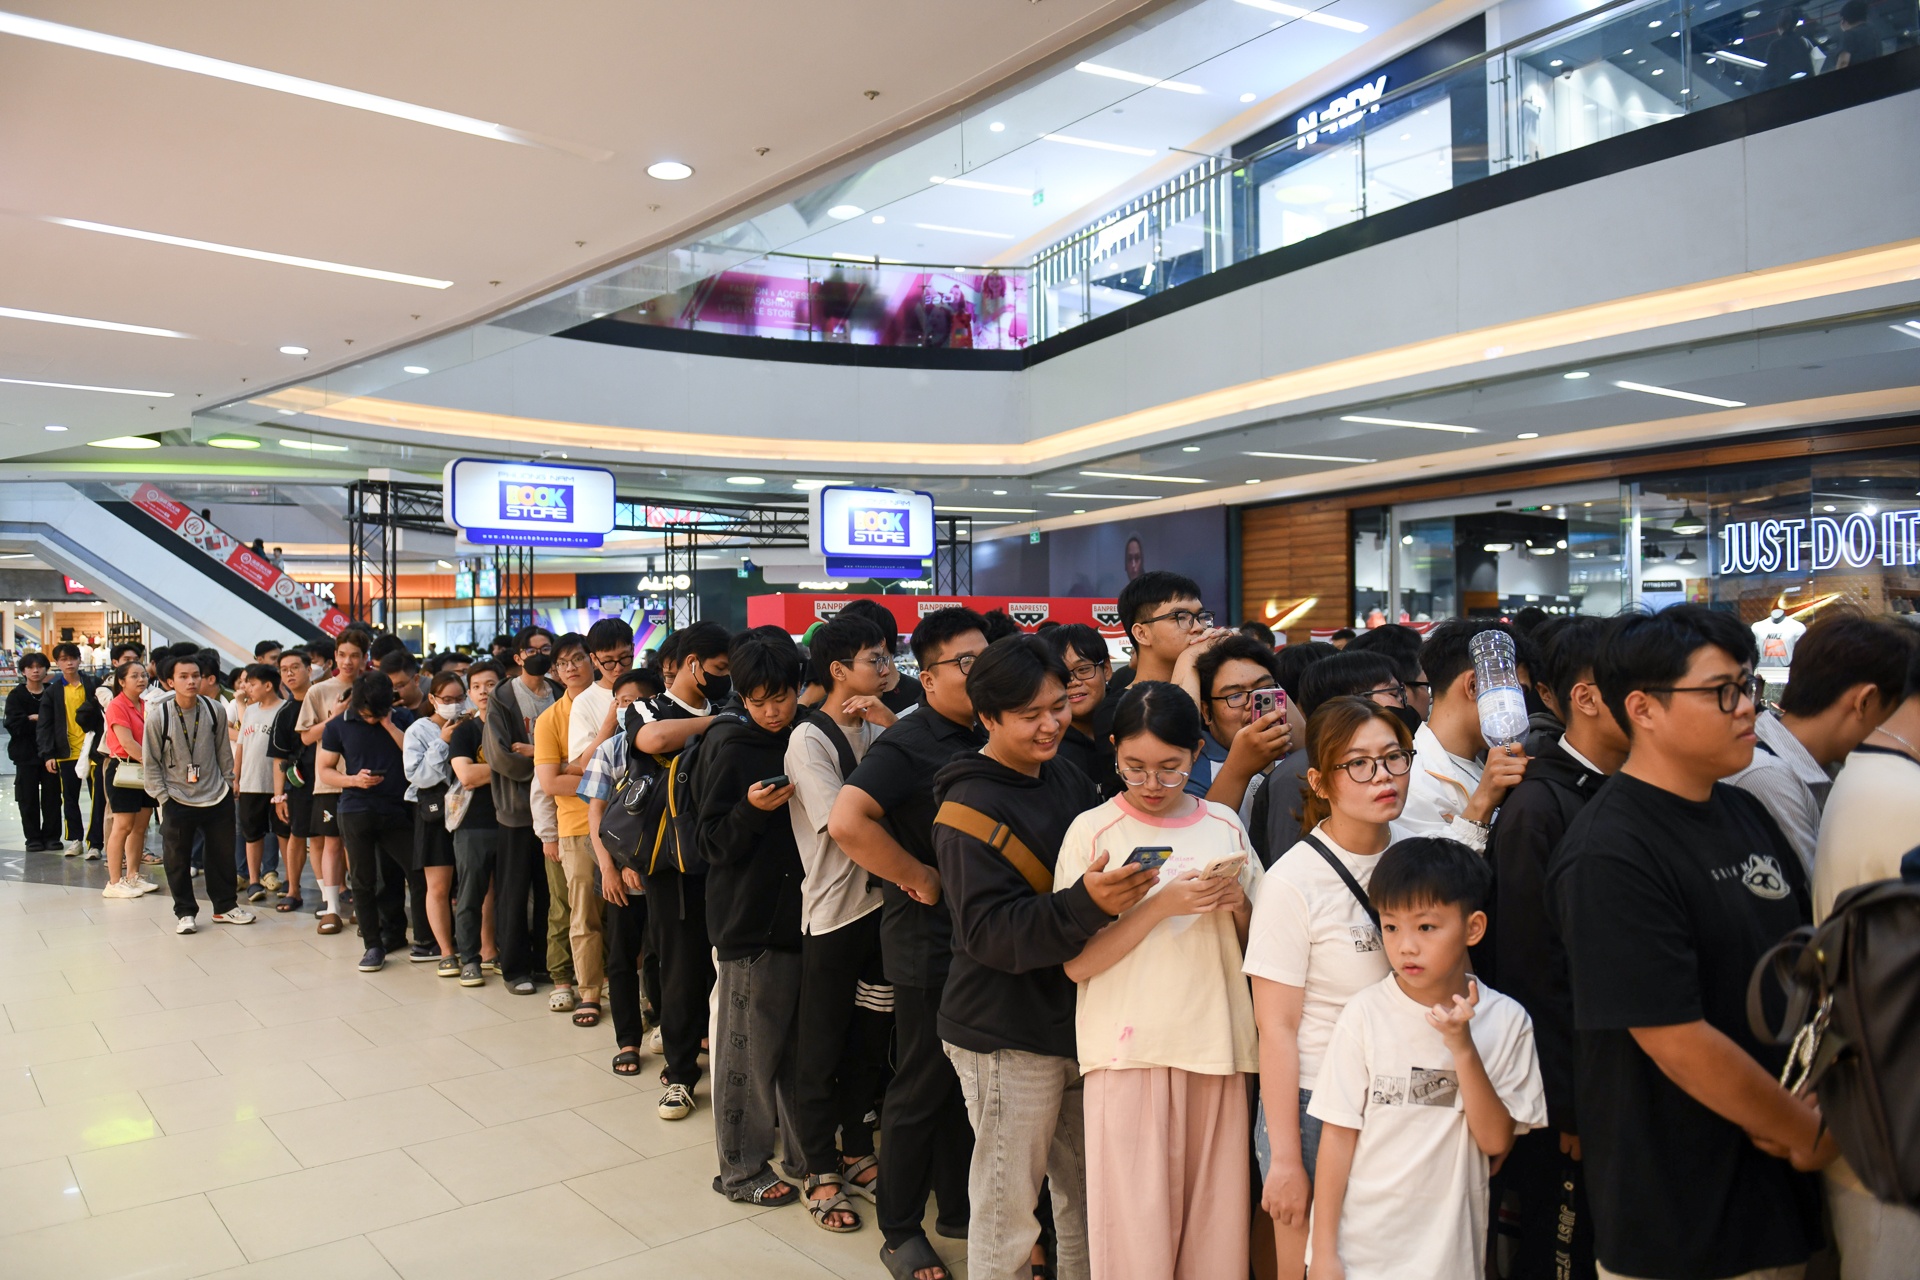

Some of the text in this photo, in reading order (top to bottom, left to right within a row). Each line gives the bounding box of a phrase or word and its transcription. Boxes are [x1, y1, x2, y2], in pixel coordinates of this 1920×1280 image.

[755, 297, 794, 309] FASHION
[767, 308, 796, 319] STORE
[550, 474, 575, 483] NAM
[506, 484, 566, 508] BOOK
[506, 505, 567, 520] STORE
[854, 510, 904, 532] BOOK
[854, 530, 905, 544] STORE
[1721, 519, 1805, 575] JUST
[1811, 512, 1876, 570] DO
[1010, 604, 1048, 612] BANPRESTO
[1557, 1204, 1576, 1244] JUST
